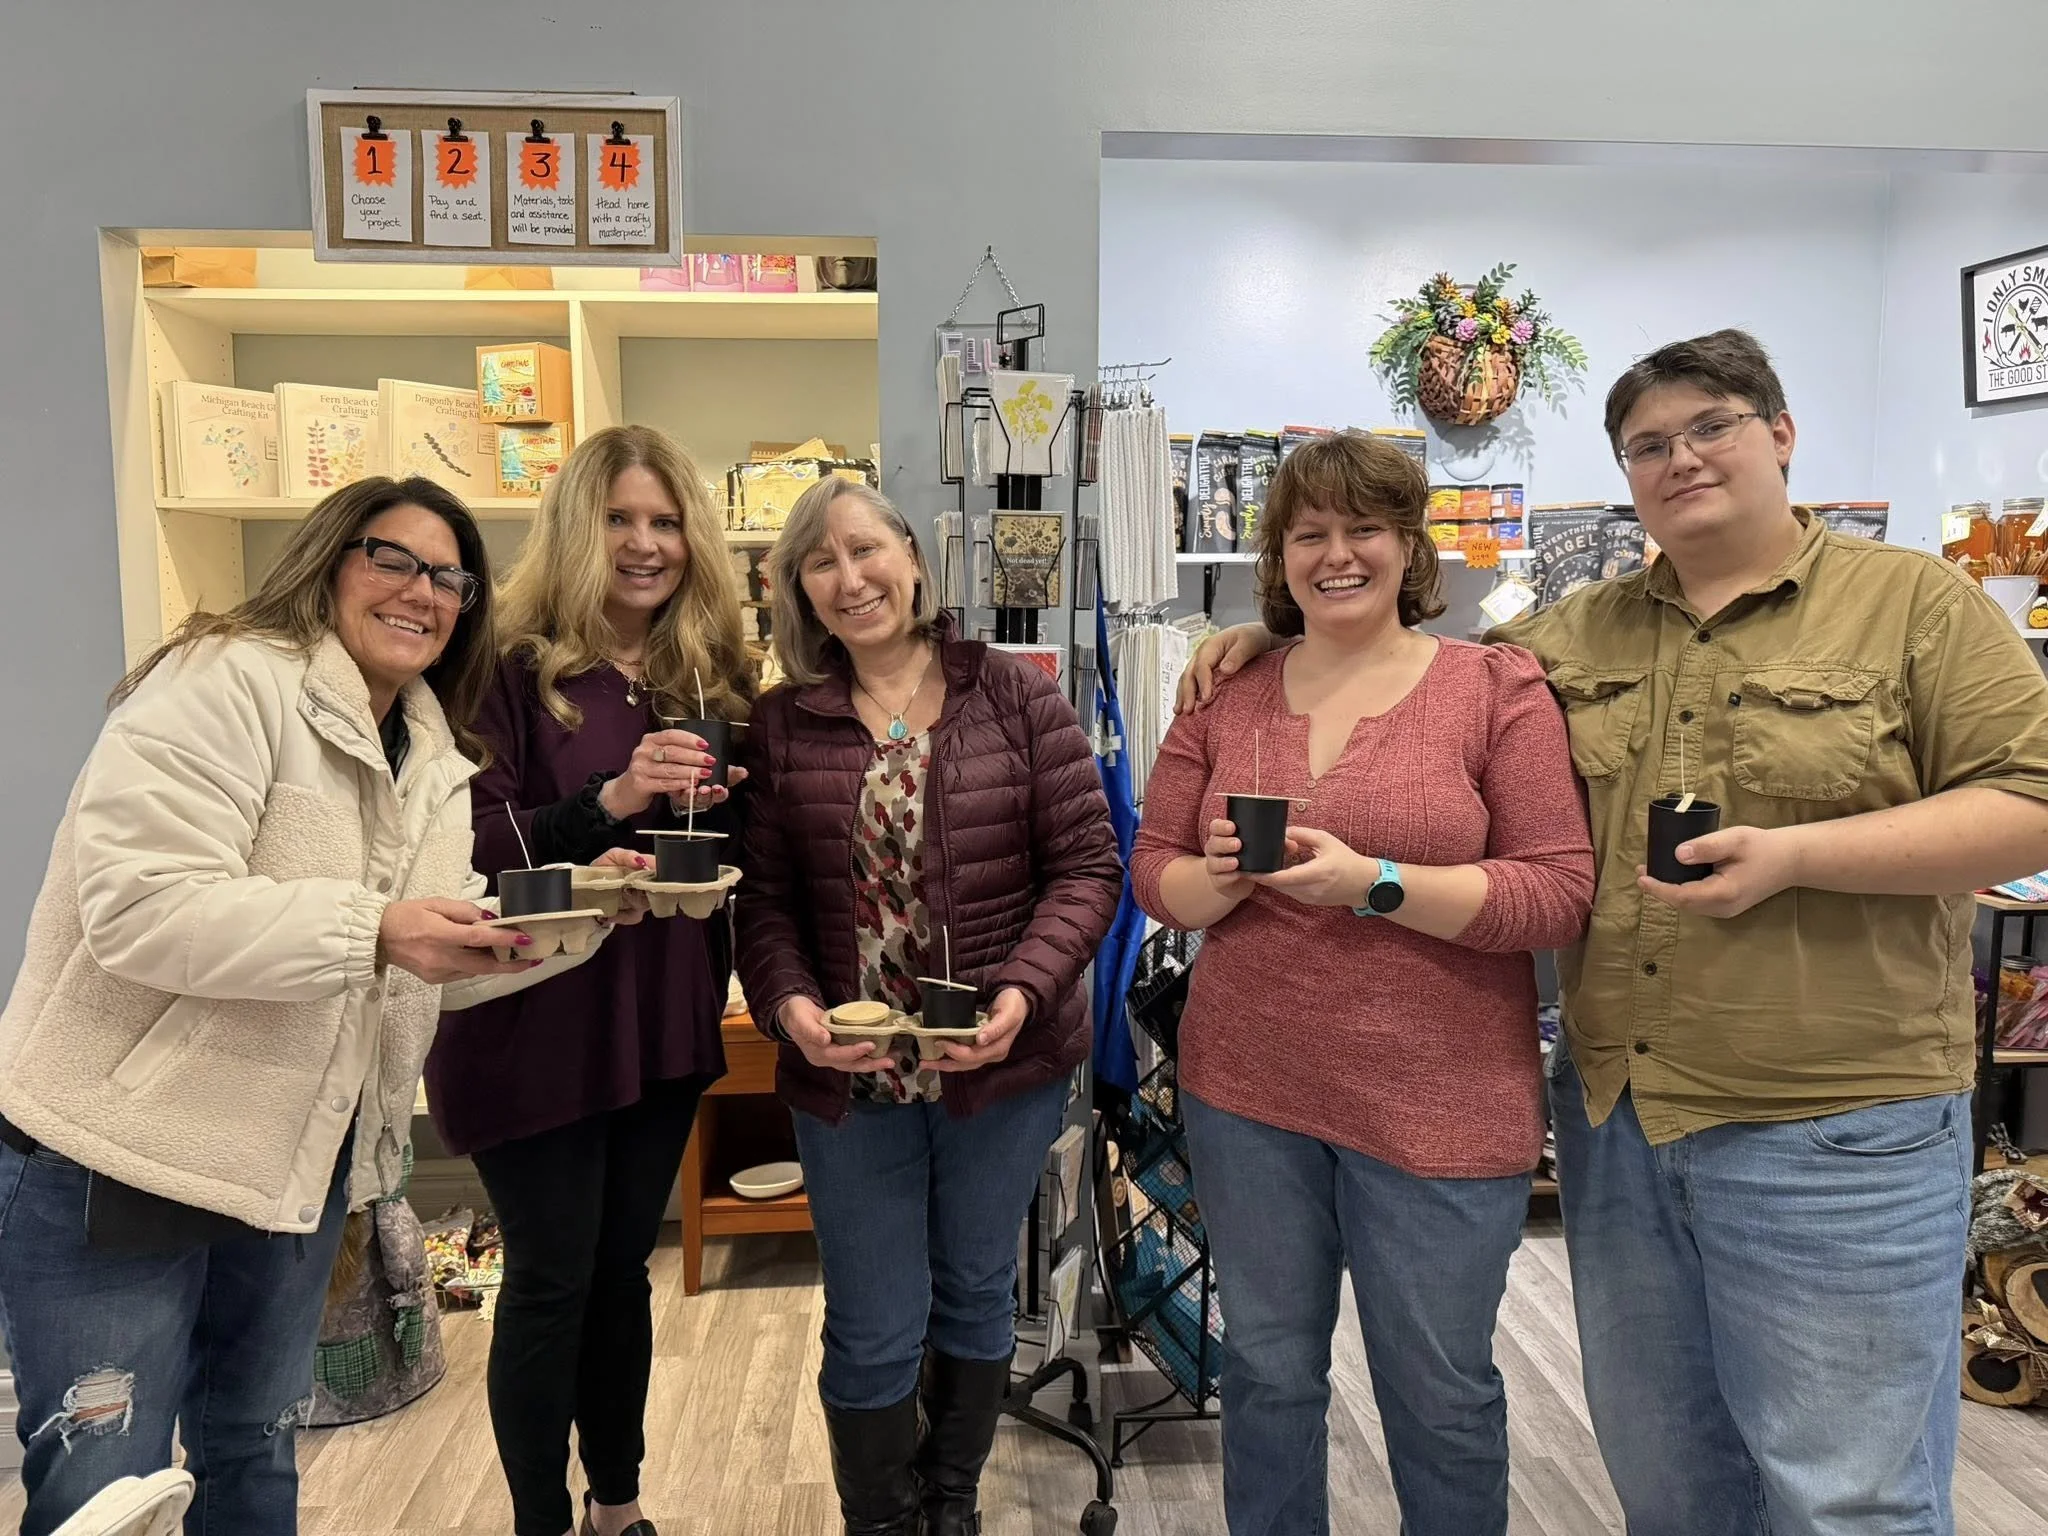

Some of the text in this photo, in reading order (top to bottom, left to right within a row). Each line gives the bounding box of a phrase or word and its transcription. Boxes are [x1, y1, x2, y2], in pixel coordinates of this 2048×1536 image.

[367, 145, 383, 175] 1
[446, 148, 470, 175] 2
[530, 152, 551, 178] 3
[610, 152, 633, 182] 4
[351, 194, 386, 206] Choose
[428, 195, 478, 210] Pay and
[513, 193, 574, 208] Materials, tools
[595, 197, 650, 209] Head home
[360, 208, 382, 222] your
[429, 210, 449, 220] find
[461, 211, 487, 222] seat.
[510, 208, 570, 220] and assistance
[592, 212, 652, 229] with a crafty
[512, 223, 528, 233] will
[530, 223, 540, 234] be
[598, 224, 647, 240] masterpiece!
[1986, 269, 2017, 313] ONLY
[1989, 372, 2005, 388] THE
[2008, 367, 2033, 384] GOOD
[201, 395, 240, 409] Michigan
[241, 401, 266, 411] Beach
[320, 395, 340, 405] Fern
[342, 396, 369, 407] Beach
[415, 394, 478, 410] Dragonfly Beach
[221, 407, 269, 420] Crafting Kit
[332, 405, 369, 417] Crafting
[435, 406, 469, 419] Crafting
[1241, 456, 1254, 501] DELIGHTFUL
[1199, 455, 1217, 538] Simply DELIGHTFUL
[1541, 524, 1599, 550] EVERYTHING
[1472, 542, 1492, 551] NEW
[1543, 534, 1599, 565] BAGEL
[1034, 557, 1048, 566] yet!
